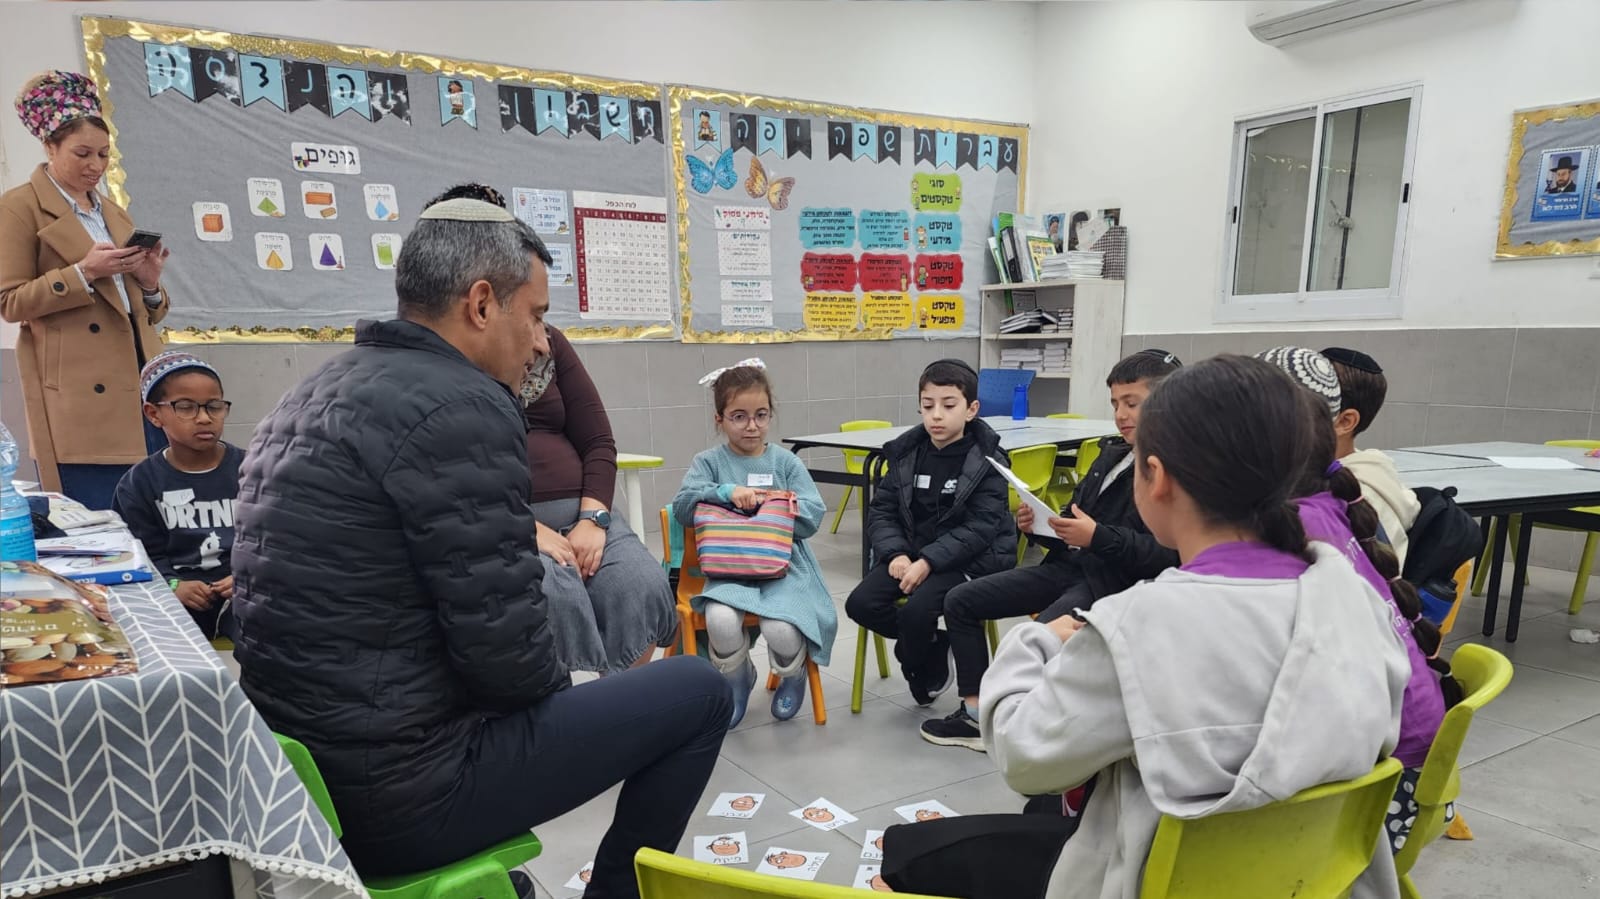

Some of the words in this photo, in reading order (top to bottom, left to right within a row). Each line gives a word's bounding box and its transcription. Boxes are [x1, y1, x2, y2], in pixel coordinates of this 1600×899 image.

[833, 126, 897, 153] שפה
[917, 131, 1014, 164] עברית
[304, 147, 356, 167] גופים
[921, 194, 954, 206] טקסטים
[929, 221, 953, 232] טקסט
[930, 262, 953, 272] טקסט
[932, 301, 956, 311] טקסט
